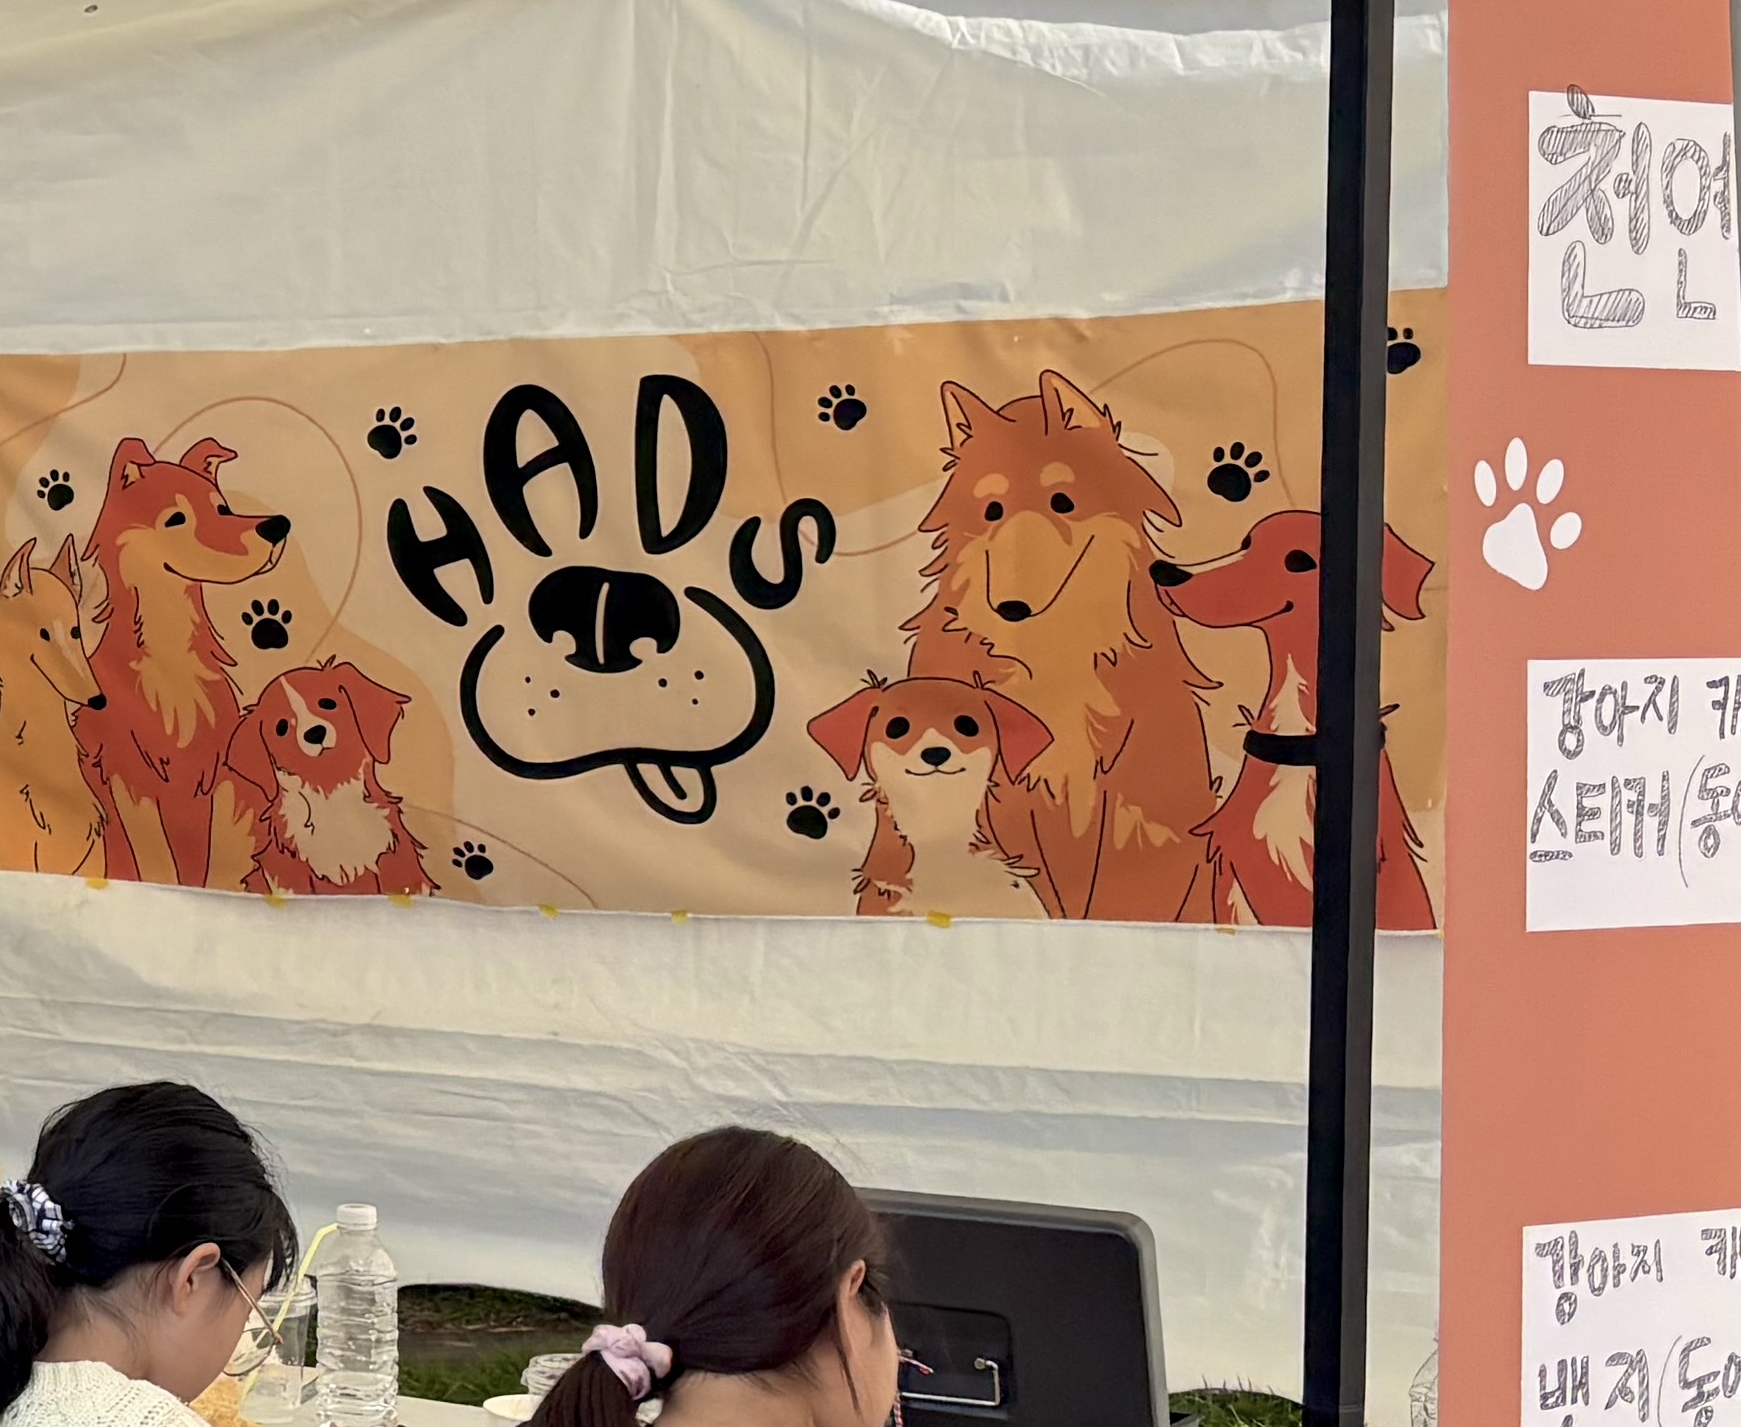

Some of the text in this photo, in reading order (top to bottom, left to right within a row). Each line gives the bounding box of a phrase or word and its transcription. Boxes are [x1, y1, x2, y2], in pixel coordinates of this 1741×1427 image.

[387, 374, 837, 627] HADS
[1543, 668, 1680, 760] 강아지
[1534, 1229, 1664, 1326] 강아지
